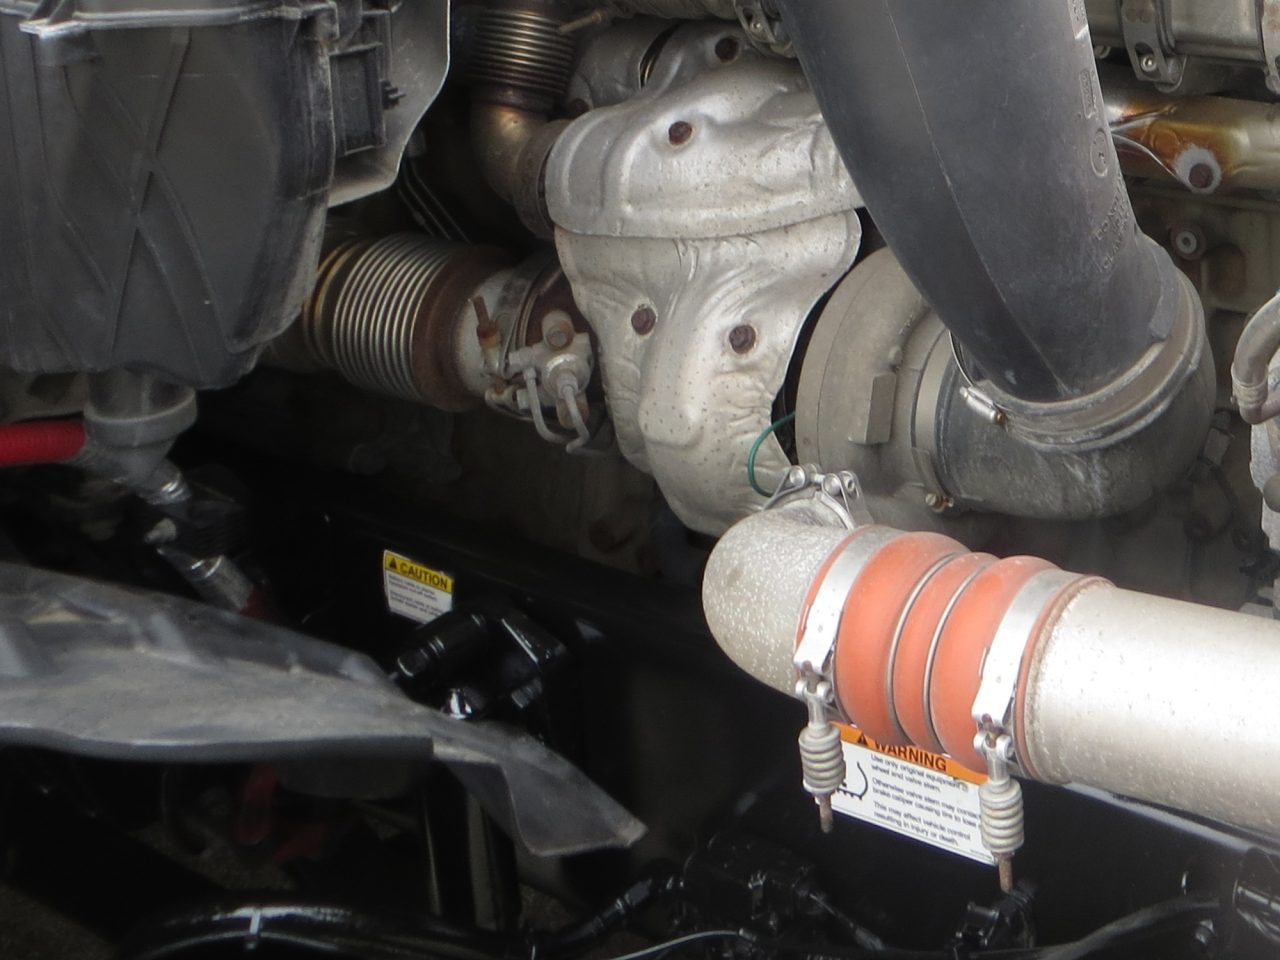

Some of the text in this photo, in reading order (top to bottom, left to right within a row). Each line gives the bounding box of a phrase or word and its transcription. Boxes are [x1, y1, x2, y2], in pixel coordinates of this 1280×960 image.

[400, 562, 448, 590] CAUTION
[871, 753, 884, 763] Use
[885, 759, 899, 770] only
[874, 740, 947, 772] WARNING
[891, 771, 903, 780] and
[872, 777, 904, 794] Otherwise
[872, 786, 891, 798] brake
[874, 800, 887, 811] This
